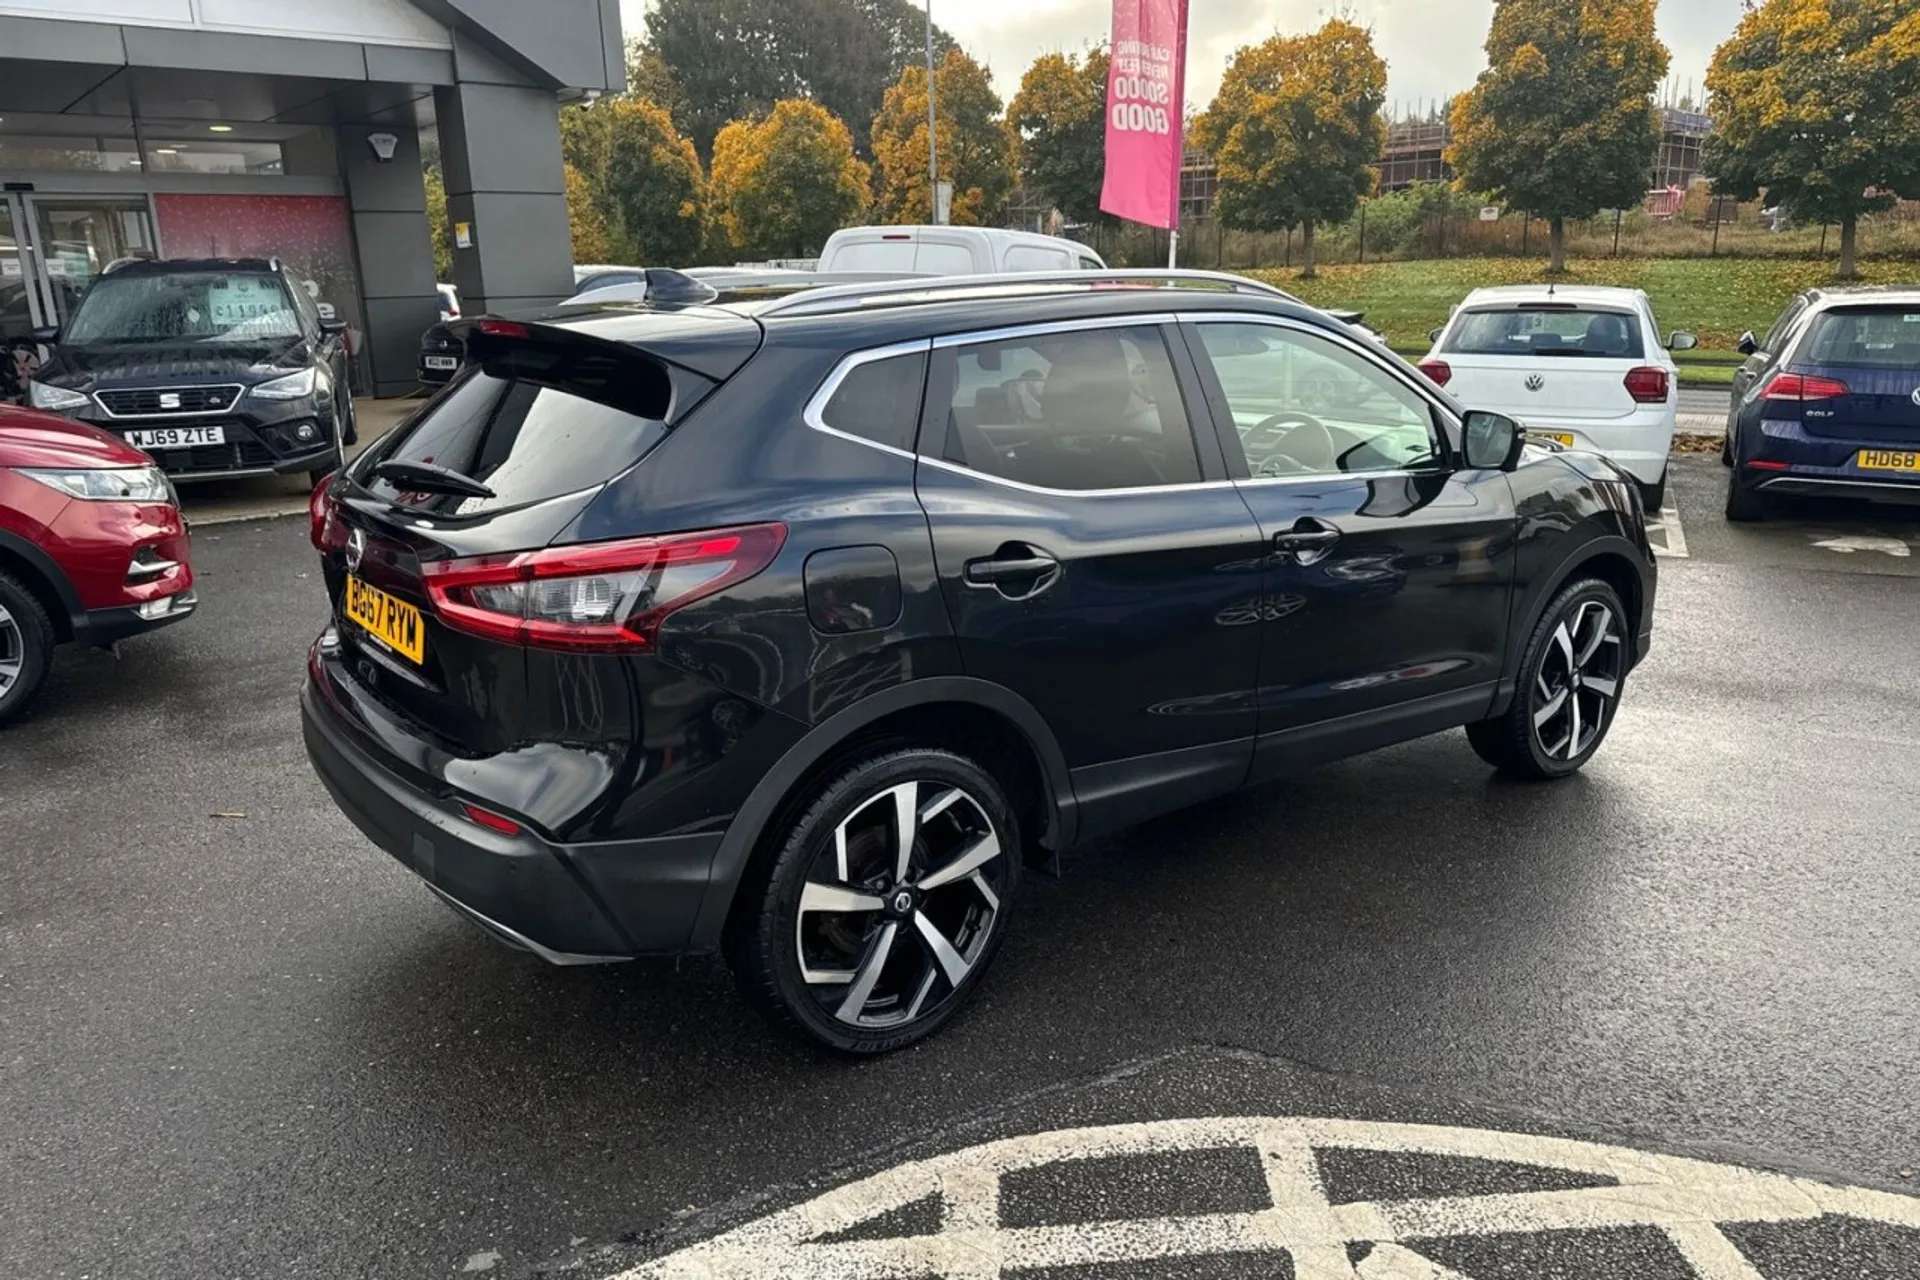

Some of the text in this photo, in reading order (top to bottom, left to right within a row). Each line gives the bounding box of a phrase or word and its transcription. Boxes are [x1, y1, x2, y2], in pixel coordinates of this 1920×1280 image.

[132, 428, 217, 446] WJ69 ZTE
[1865, 451, 1915, 467] HD68
[352, 580, 417, 652] BG67 RYW
